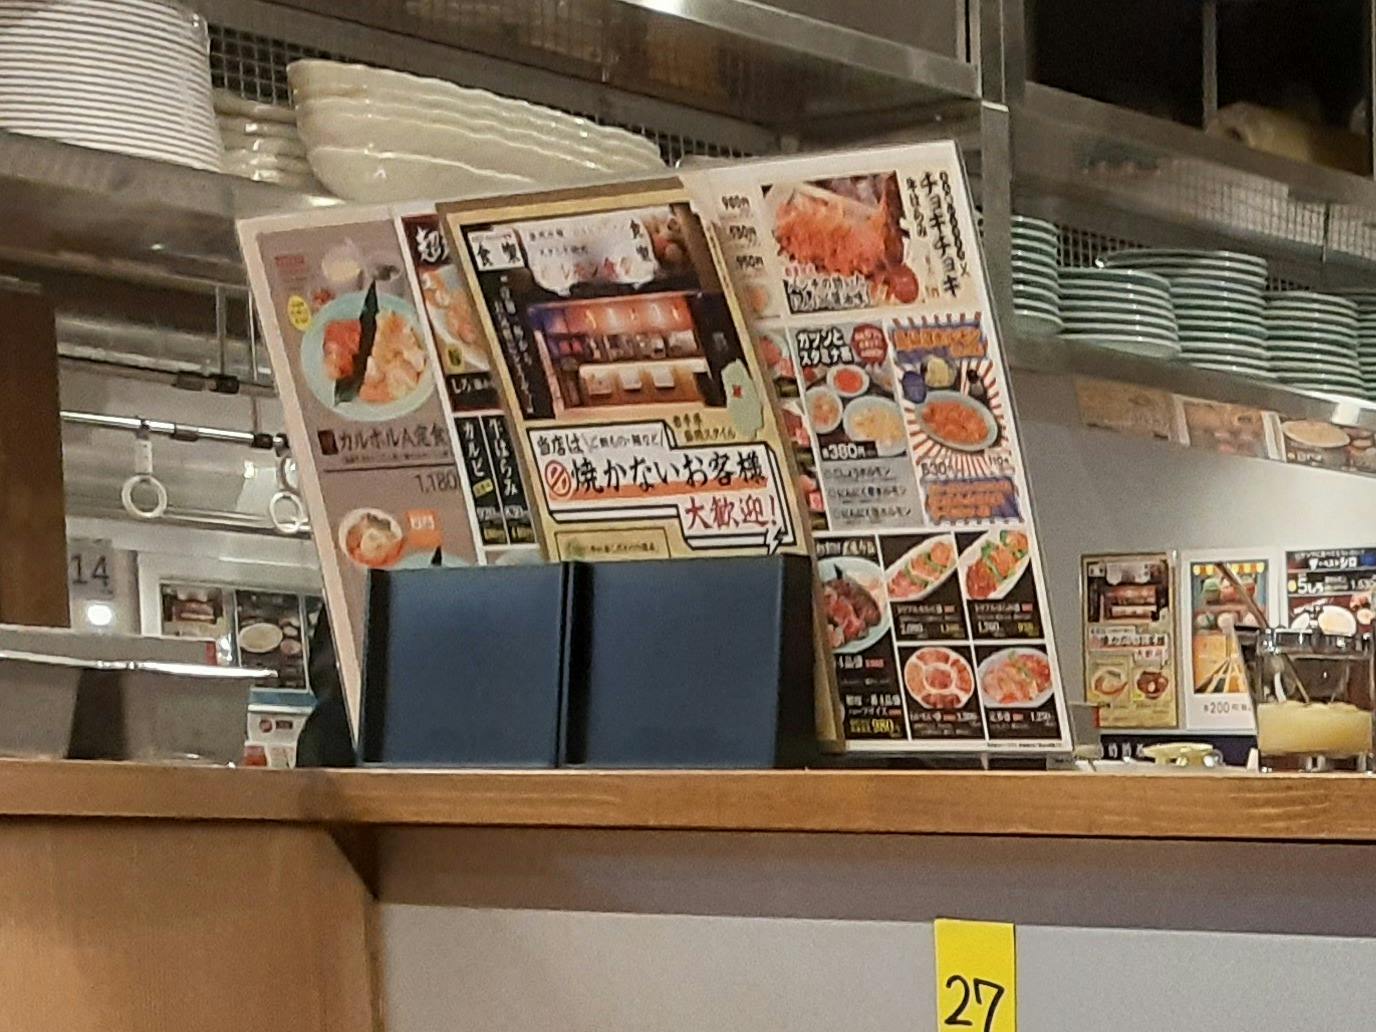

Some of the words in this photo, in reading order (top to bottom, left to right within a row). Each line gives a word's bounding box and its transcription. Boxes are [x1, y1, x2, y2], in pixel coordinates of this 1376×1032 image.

[798, 327, 845, 349] ガツンと
[462, 420, 486, 478] カルビ
[536, 431, 584, 457] 当店は
[414, 470, 461, 495] 1,180
[571, 450, 767, 493] 焼かないお客様
[685, 494, 777, 530] 大歓迎!
[71, 553, 110, 590] 14
